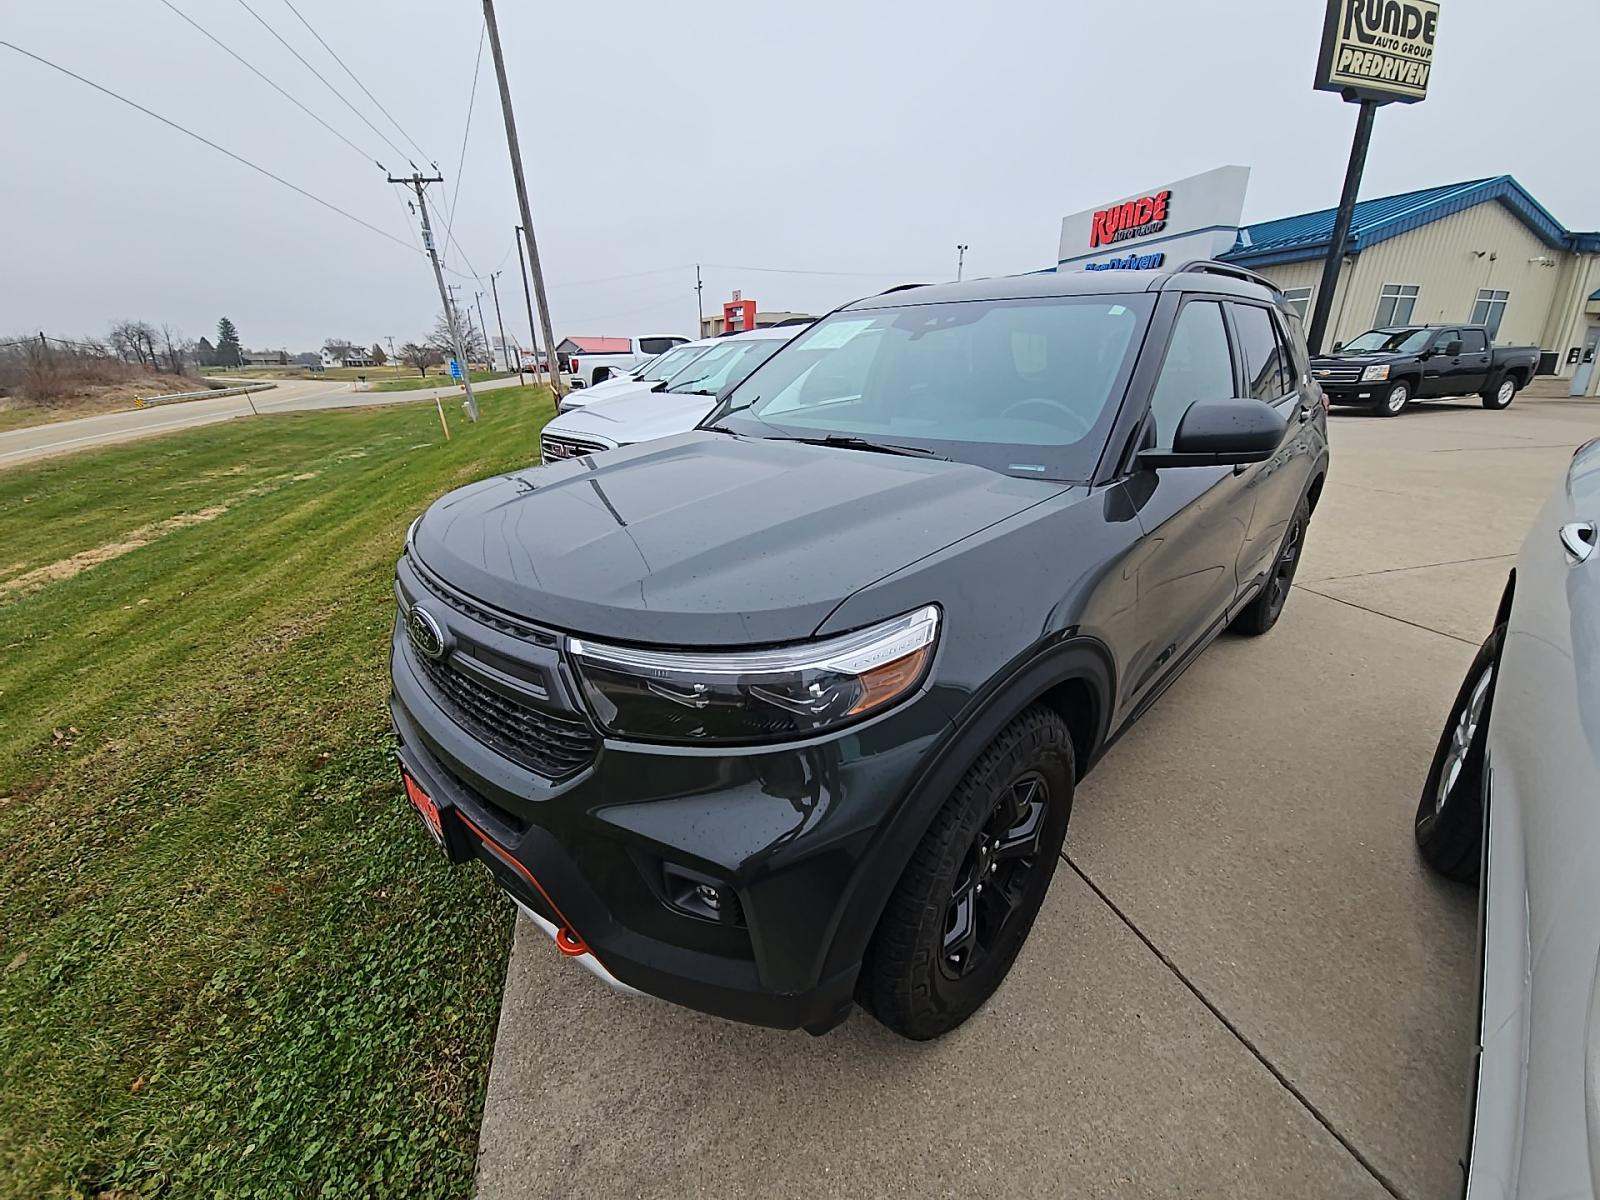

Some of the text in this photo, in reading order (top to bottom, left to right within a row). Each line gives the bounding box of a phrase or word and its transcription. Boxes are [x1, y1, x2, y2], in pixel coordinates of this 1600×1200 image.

[1342, 0, 1437, 45] RUNDE
[1375, 36, 1432, 59] AUTO GROUP
[1337, 49, 1430, 86] PREDRIVEN
[1090, 190, 1170, 248] RUNDE
[1112, 221, 1166, 243] AUTO GROUP
